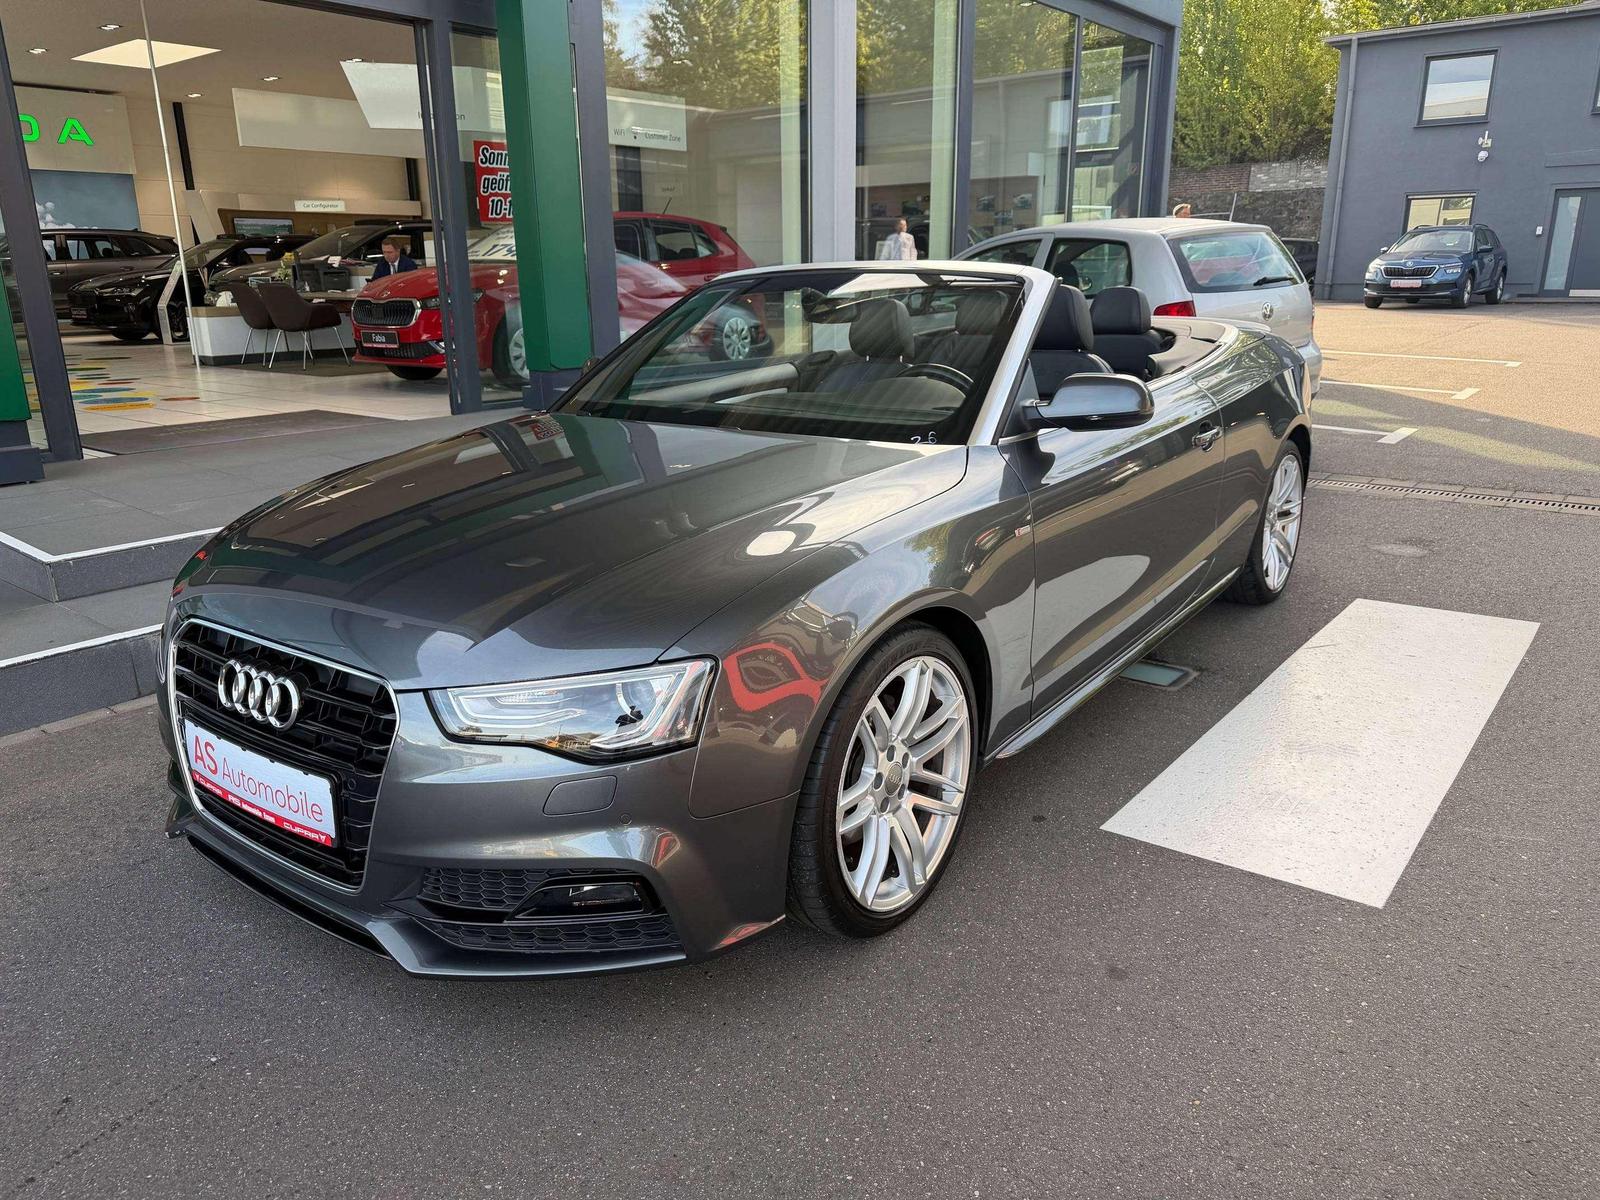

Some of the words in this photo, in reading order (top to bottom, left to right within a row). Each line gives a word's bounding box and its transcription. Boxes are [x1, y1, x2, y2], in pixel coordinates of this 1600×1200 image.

[644, 132, 668, 141] Customer
[668, 134, 681, 143] Zone
[372, 333, 386, 342] Fabia
[194, 735, 218, 775] AS
[222, 757, 324, 823] Automobile
